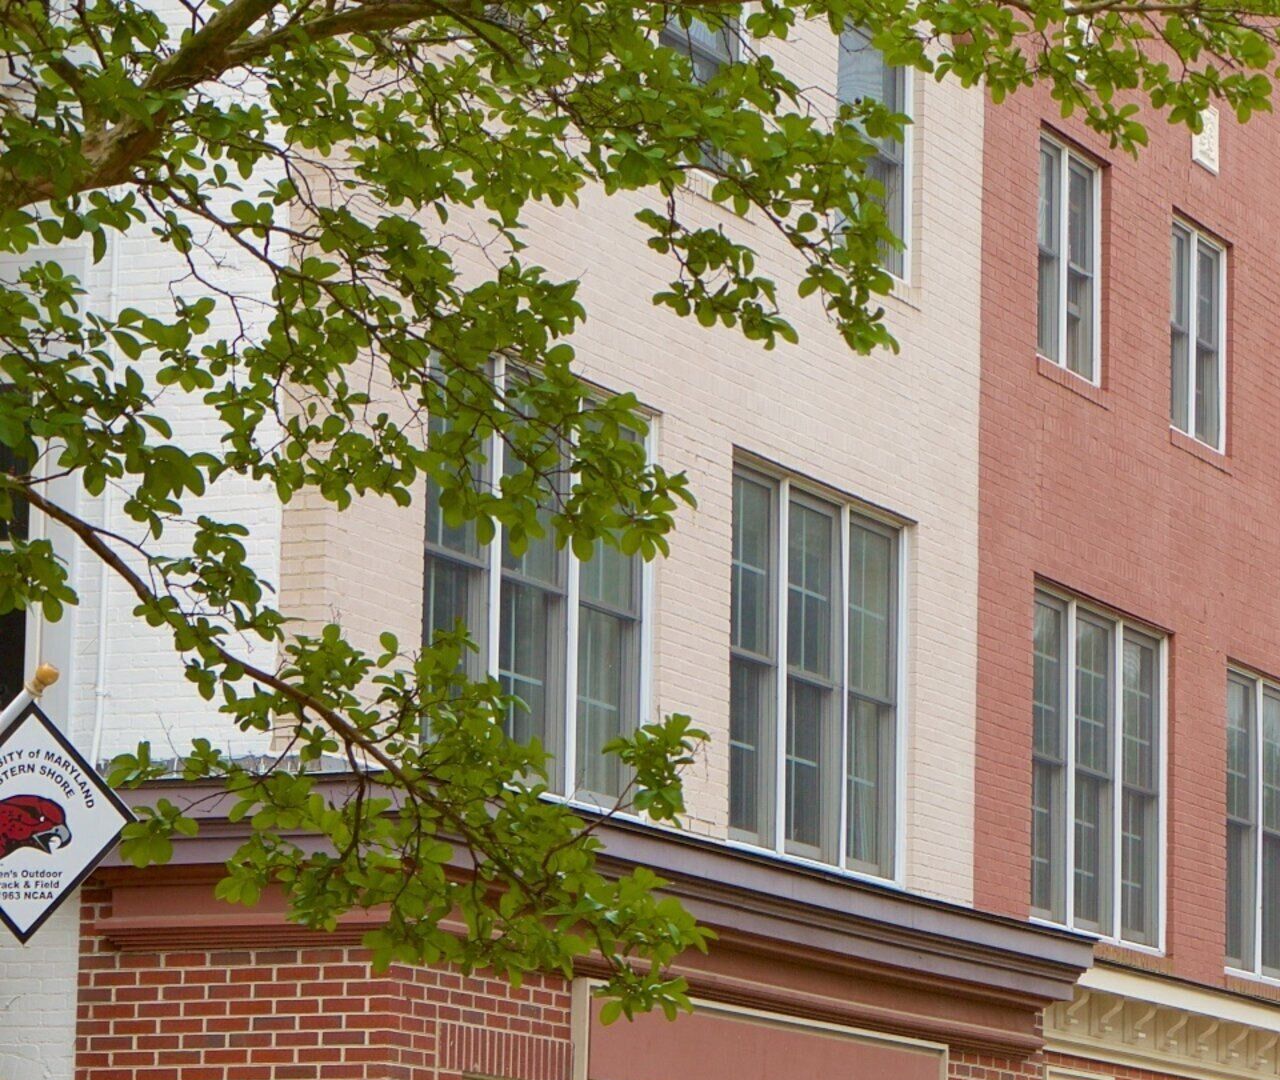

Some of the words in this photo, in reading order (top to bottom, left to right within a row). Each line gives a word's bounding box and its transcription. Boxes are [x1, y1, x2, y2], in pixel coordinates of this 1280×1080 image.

[28, 749, 41, 759] of
[44, 751, 95, 809] MARYLAND
[39, 765, 76, 799] SHORE
[21, 869, 63, 879] Outdoor
[23, 880, 31, 889] &
[34, 880, 60, 889] Field
[24, 891, 54, 900] NCAA
